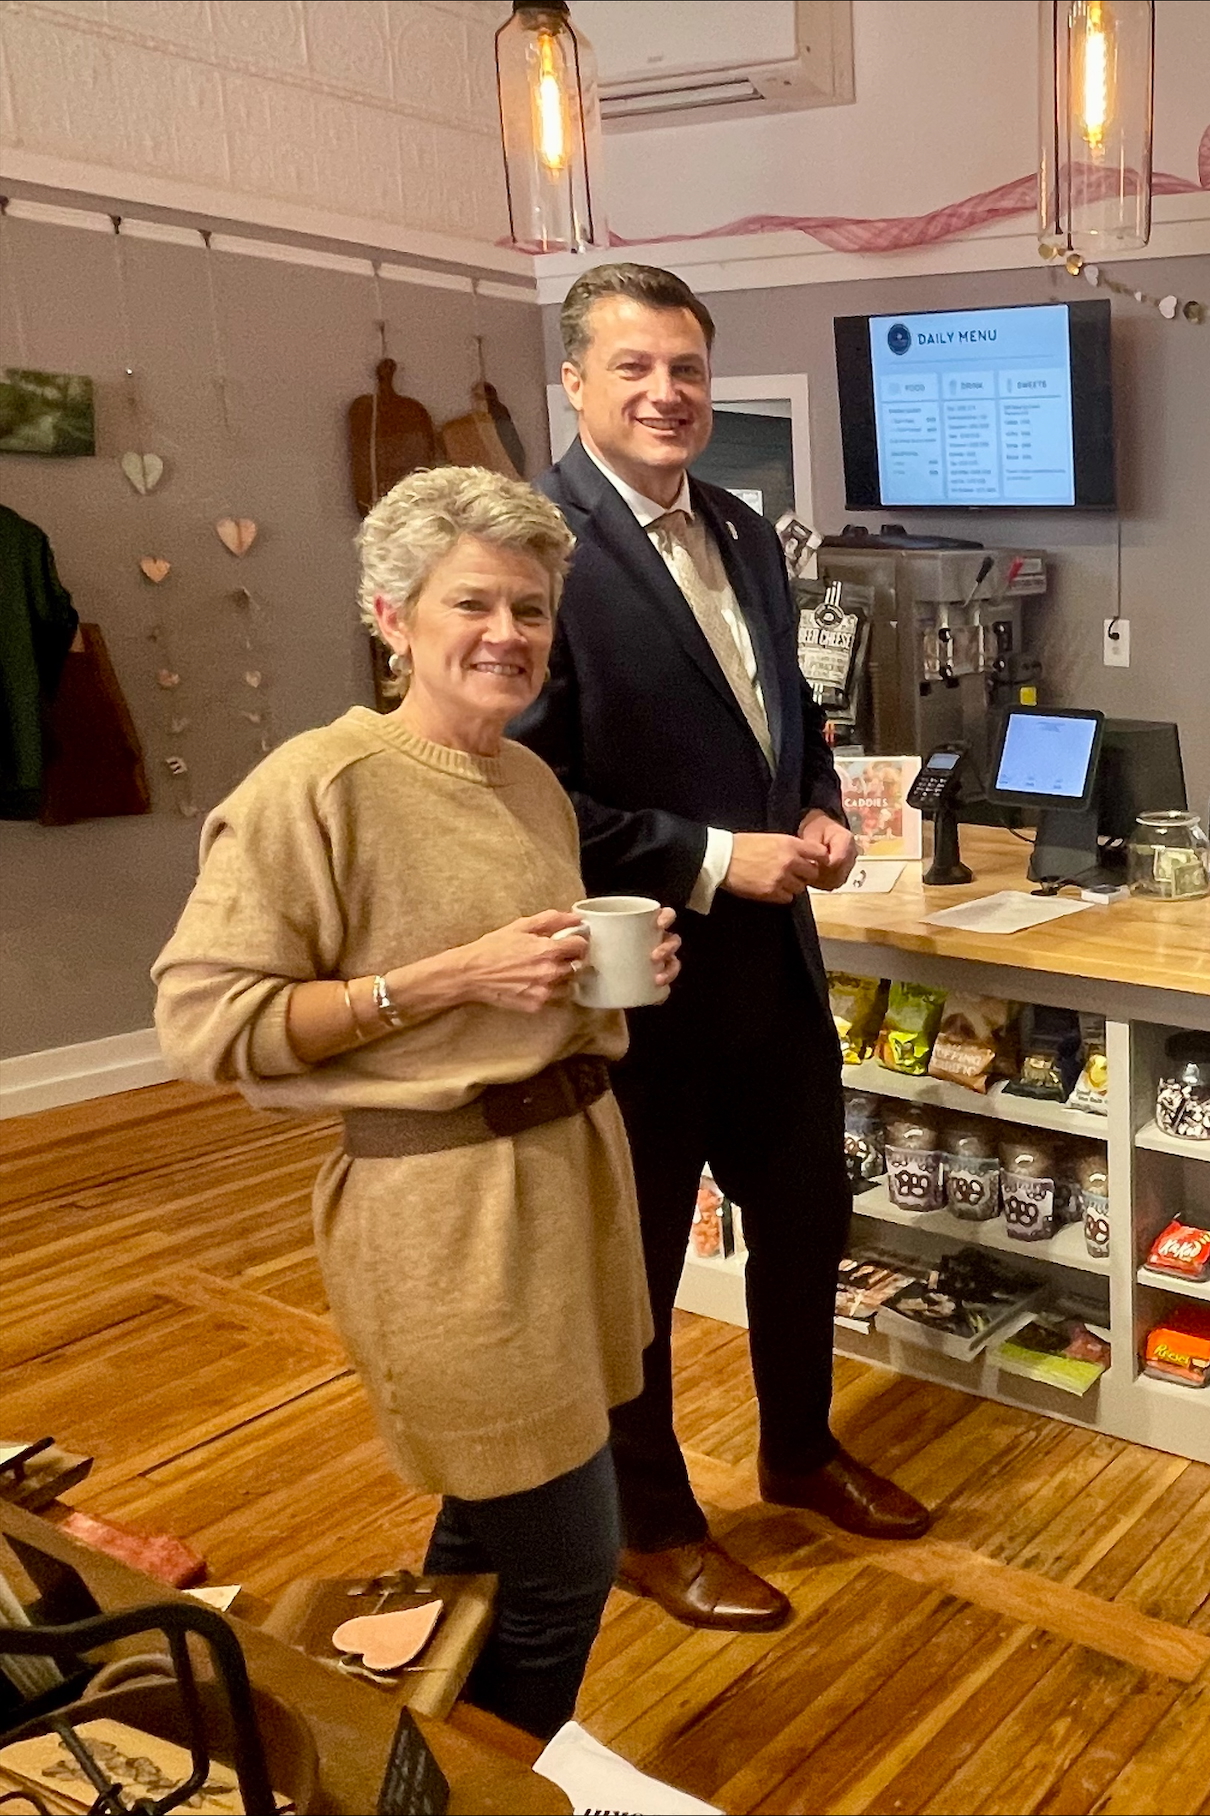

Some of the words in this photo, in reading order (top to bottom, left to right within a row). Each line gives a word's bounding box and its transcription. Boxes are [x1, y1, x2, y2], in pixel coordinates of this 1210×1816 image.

[917, 332, 954, 345] DAILY
[958, 329, 997, 343] MENU
[1016, 379, 1048, 389] SWEETS
[819, 628, 853, 650] CHEESE
[844, 797, 889, 808] CADDIES
